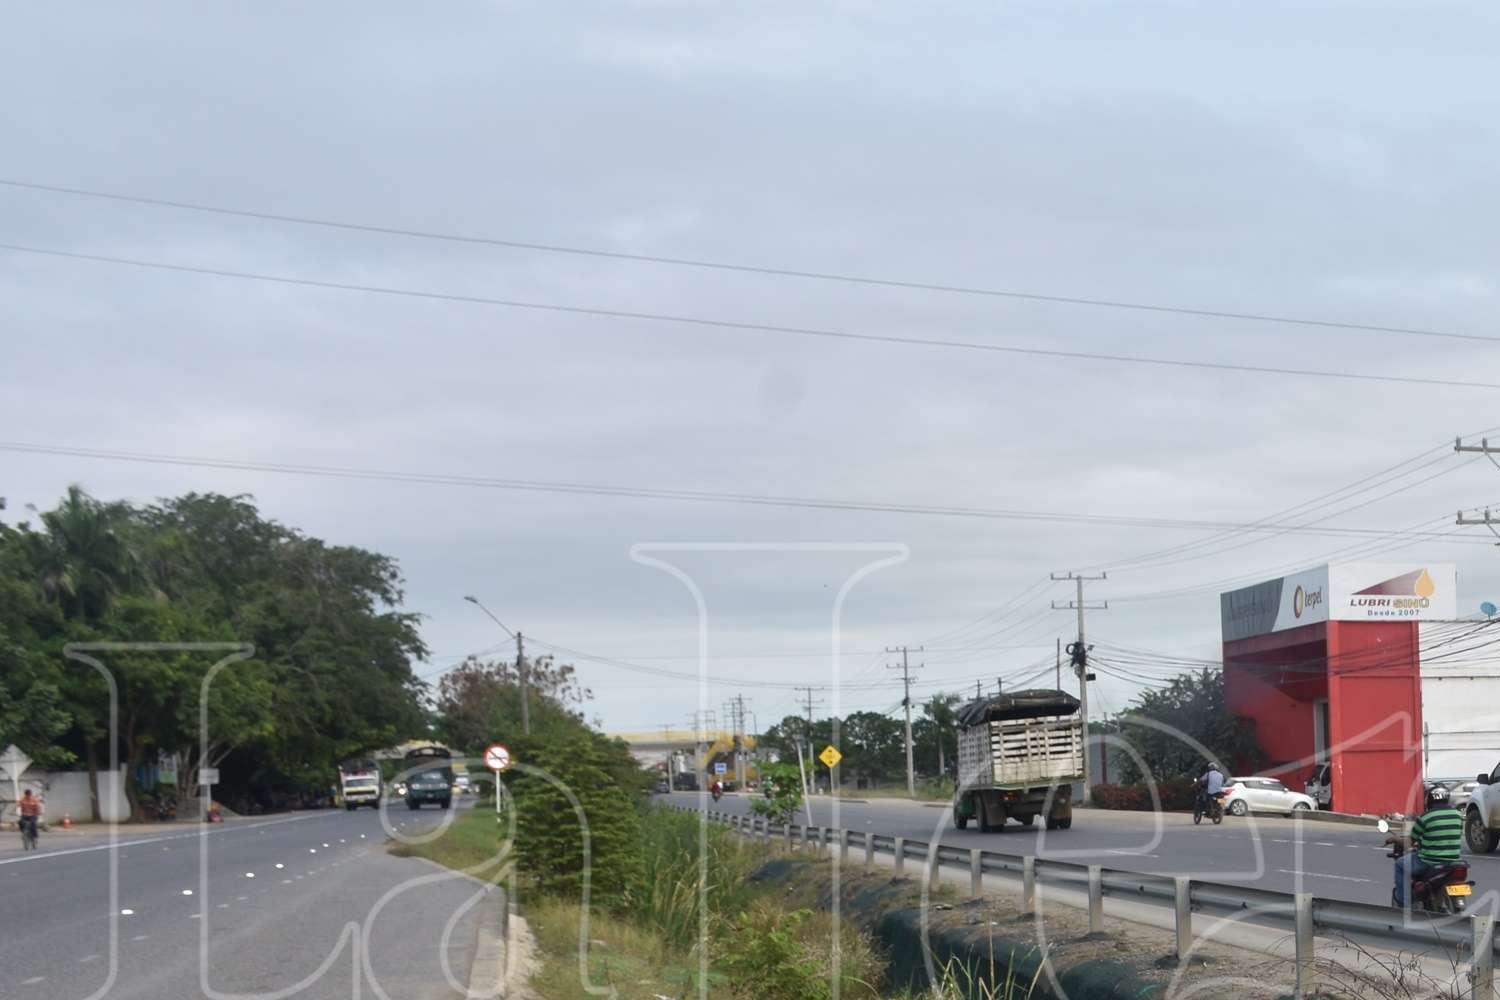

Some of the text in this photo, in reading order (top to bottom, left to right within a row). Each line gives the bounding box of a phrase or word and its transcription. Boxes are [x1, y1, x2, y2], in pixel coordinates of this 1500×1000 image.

[1304, 585, 1322, 610] terpel
[1350, 598, 1391, 607] LUBRI
[1398, 608, 1420, 616] 2007
